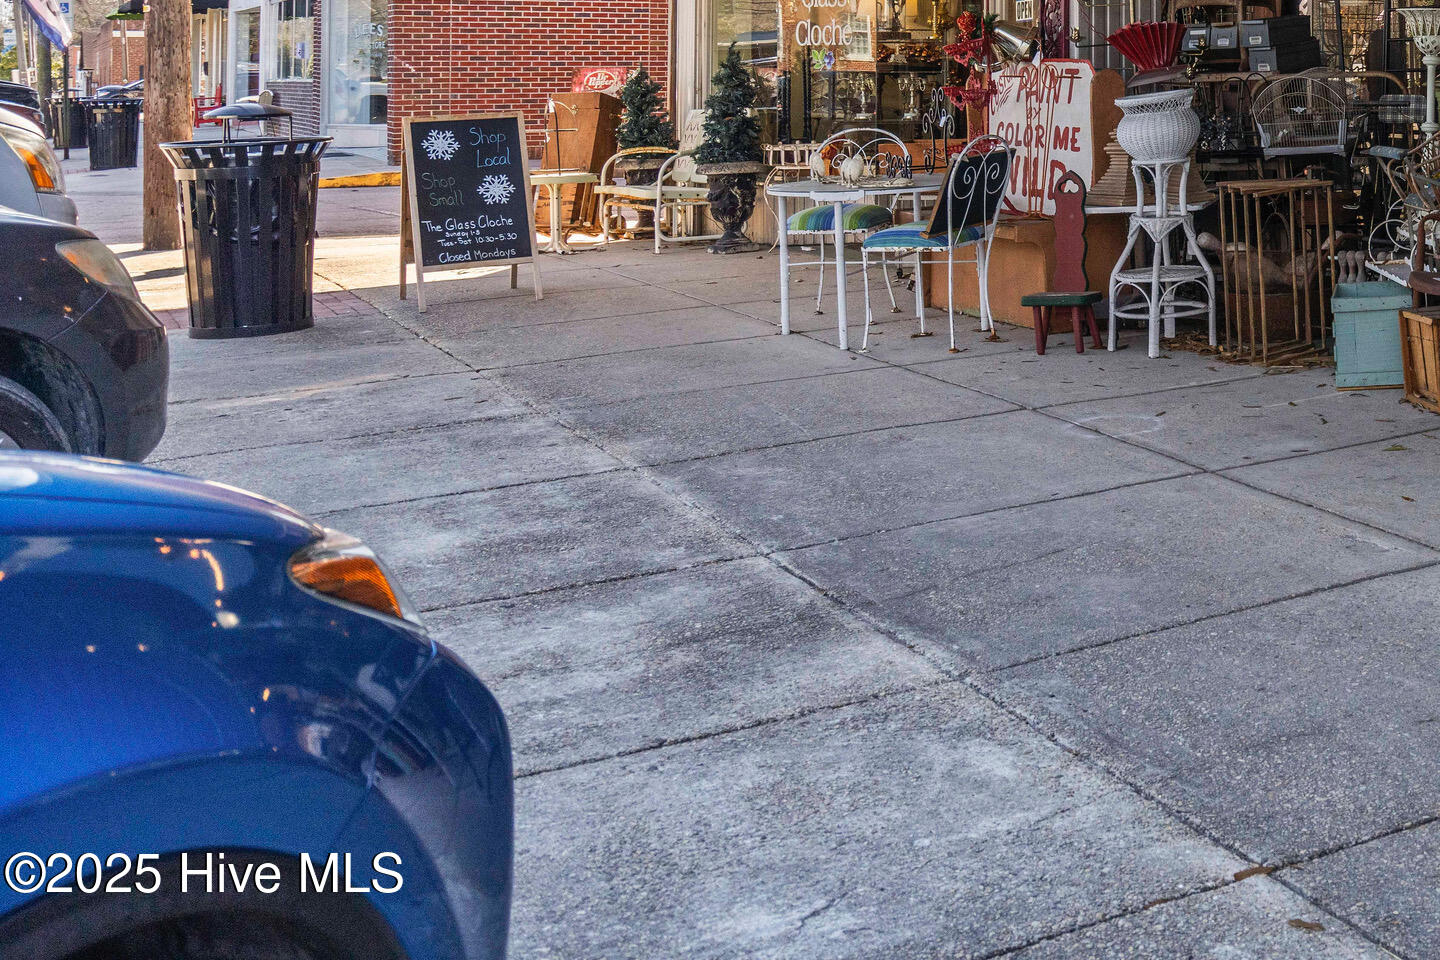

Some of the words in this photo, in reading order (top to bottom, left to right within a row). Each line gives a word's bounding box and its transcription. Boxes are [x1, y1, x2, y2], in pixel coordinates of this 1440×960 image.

[1017, 1, 1033, 19] OPEN
[795, 19, 853, 47] Cloche
[588, 77, 614, 88] Pepper
[597, 72, 608, 81] Dr
[1016, 68, 1080, 104] PAINT
[469, 127, 506, 152] Shop
[997, 121, 1045, 148] COLOR
[1053, 125, 1081, 152] ME
[476, 146, 511, 168] Local
[421, 172, 456, 192] Shop
[429, 190, 465, 206] Small
[421, 220, 443, 232] The
[445, 218, 476, 231] Glass
[478, 214, 514, 228] Cloche
[445, 230, 469, 238] Sunday
[438, 250, 472, 263] Closed
[473, 247, 517, 260] Mondays
